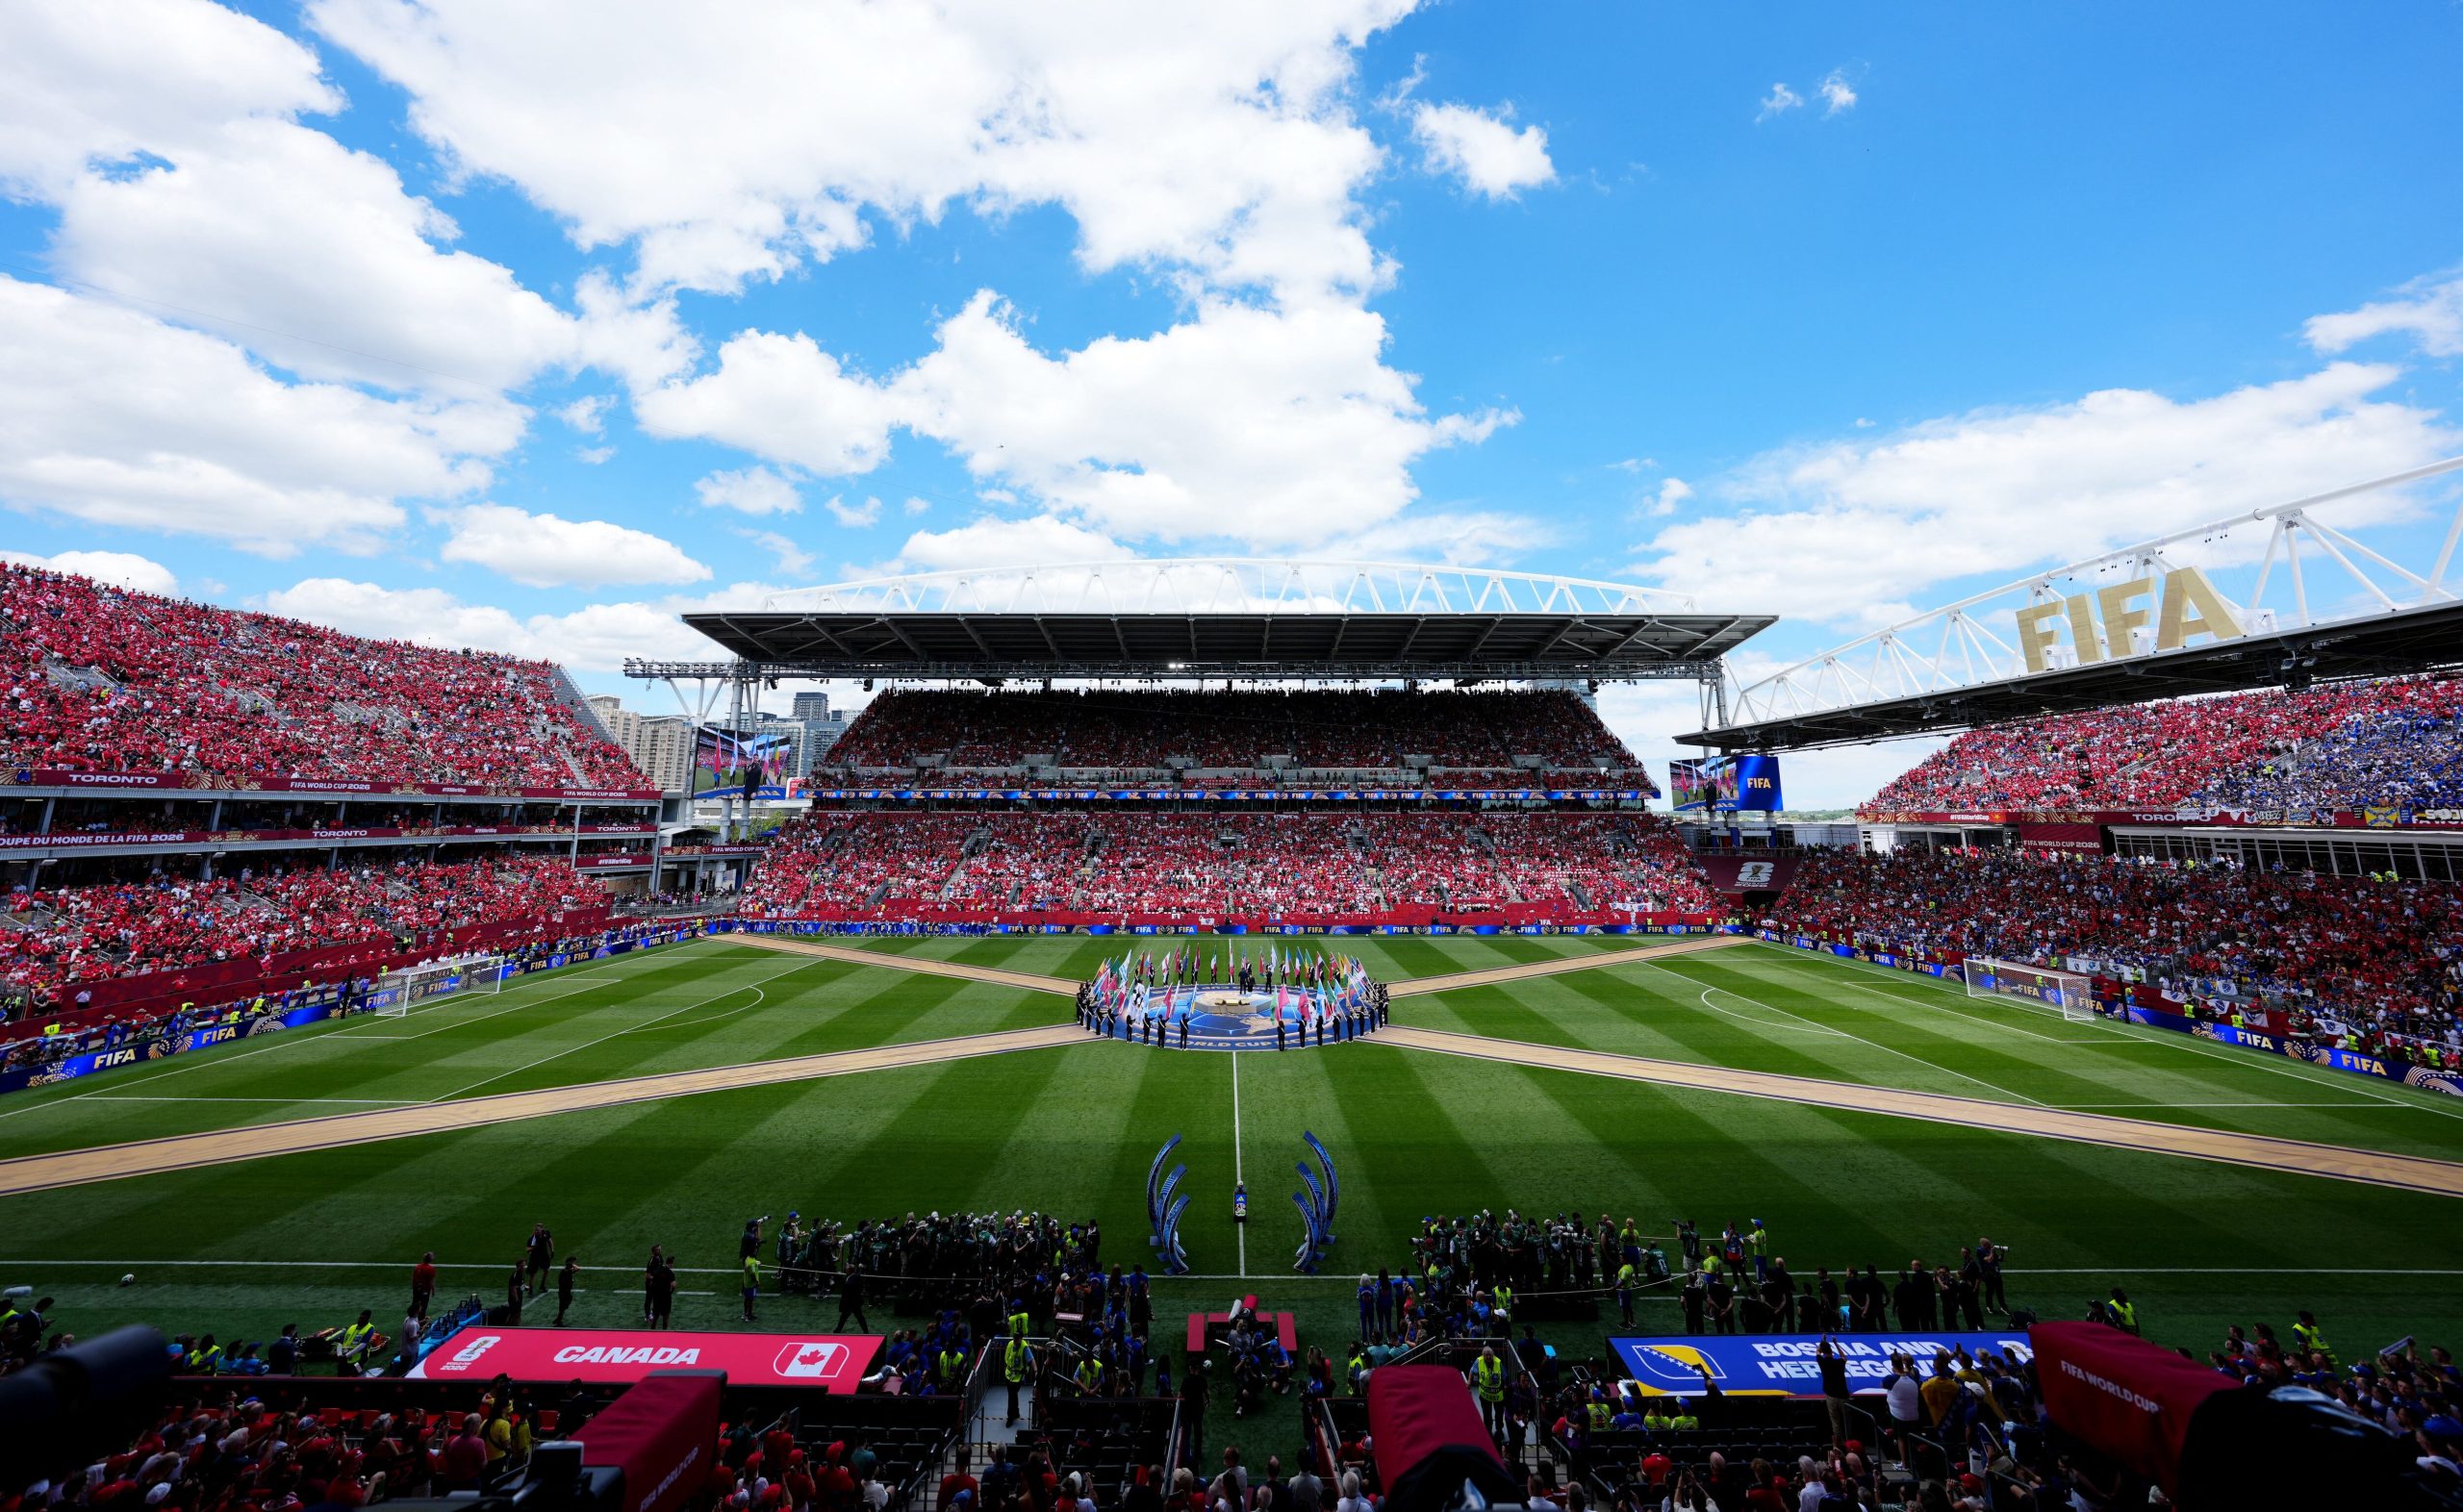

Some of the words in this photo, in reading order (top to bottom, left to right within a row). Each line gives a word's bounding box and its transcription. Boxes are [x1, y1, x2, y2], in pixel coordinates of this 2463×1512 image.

[2016, 566, 2247, 673] FIFA
[69, 773, 158, 784] TORONTO
[1746, 777, 1771, 789] FIFA
[2132, 814, 2211, 822] TOROO
[32, 837, 50, 845] DU
[52, 836, 92, 844] MONDE
[649, 937, 662, 945] FIFA
[680, 930, 693, 939] FIFA
[1767, 932, 1781, 941] FIFA
[1800, 939, 1814, 948] FIFA
[574, 950, 590, 961] FIFA
[1873, 953, 1891, 965] FIFA
[531, 960, 547, 970] FIFA
[1917, 962, 1935, 973] FIFA
[428, 981, 449, 994] FIFA
[2019, 983, 2041, 998] FIFA
[366, 993, 391, 1009] FIFA
[2078, 996, 2105, 1012] FIFA
[202, 1026, 237, 1045] FIFA
[2236, 1030, 2274, 1050] FIFA
[93, 1048, 137, 1069] FIFA
[2341, 1053, 2388, 1076] FIFA
[1879, 1341, 1951, 1356] AND
[553, 1346, 701, 1365] CANADA
[2061, 1359, 2087, 1382] FIFA
[2085, 1371, 2134, 1403] WORLD
[2133, 1394, 2160, 1415] CUP
[657, 1461, 684, 1498] WORLD
[683, 1446, 699, 1470] CUP
